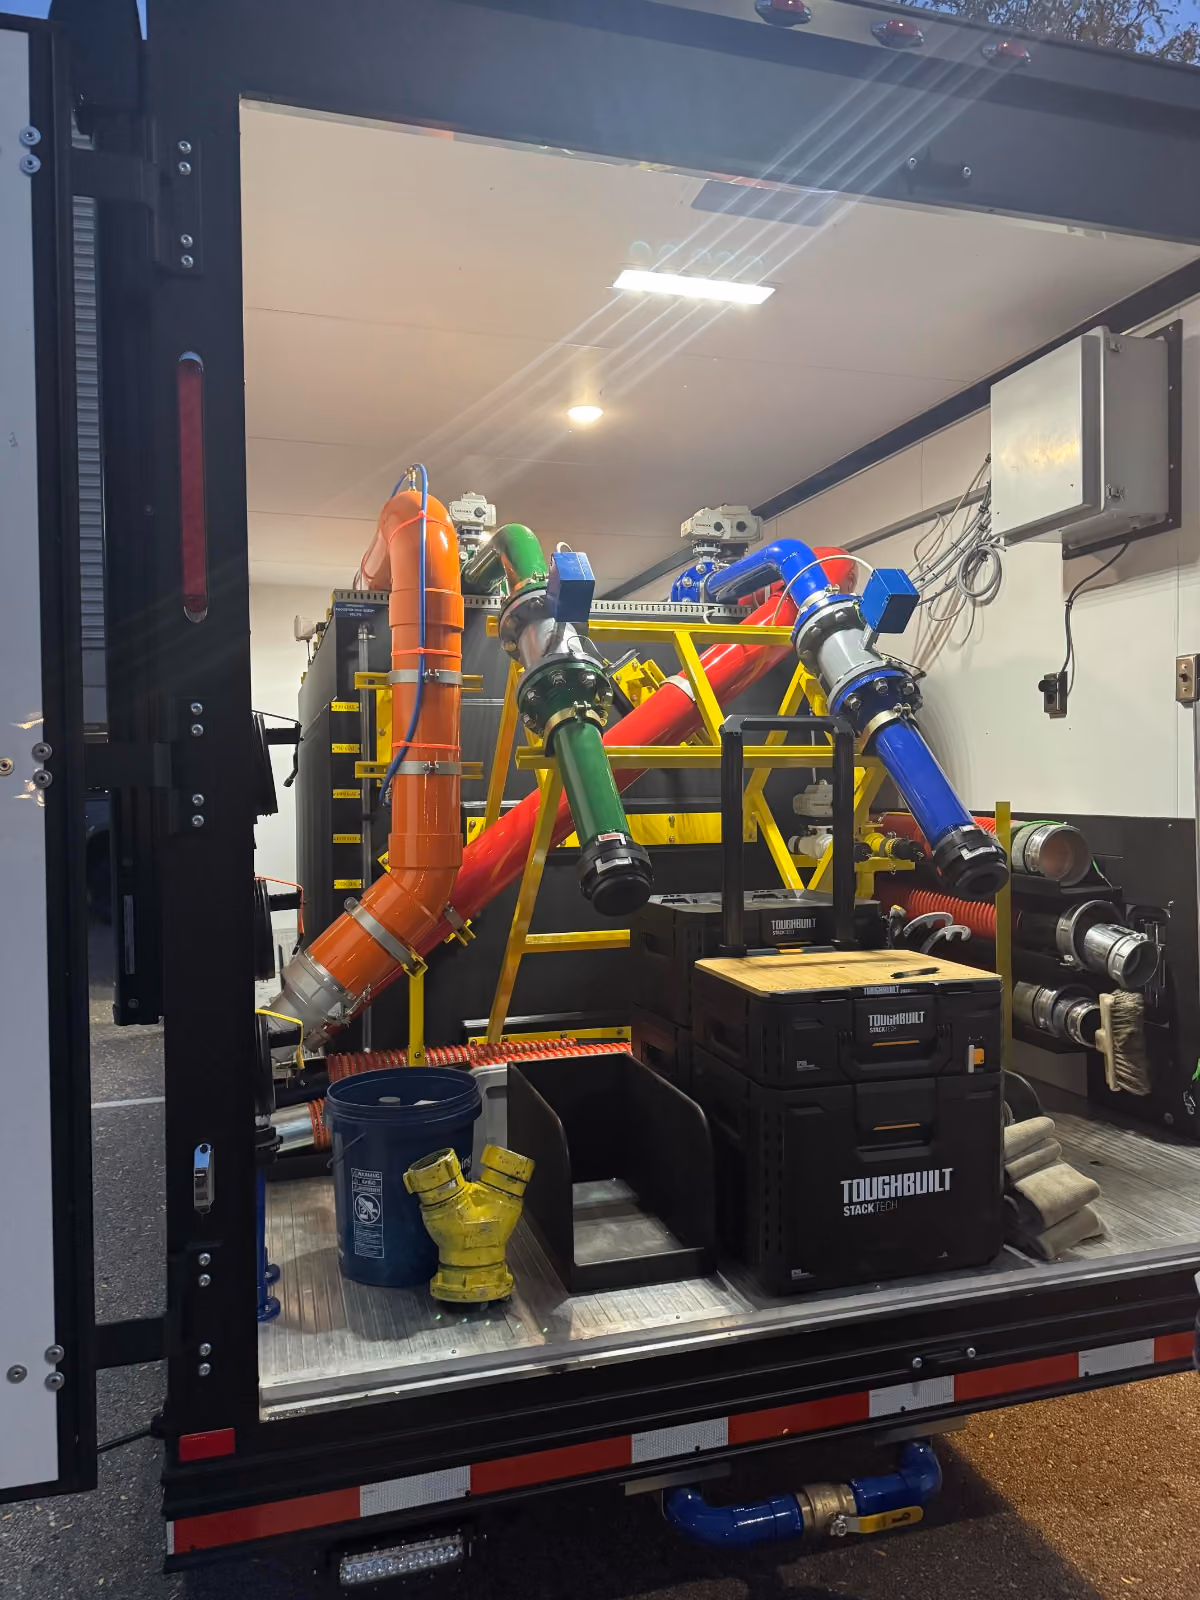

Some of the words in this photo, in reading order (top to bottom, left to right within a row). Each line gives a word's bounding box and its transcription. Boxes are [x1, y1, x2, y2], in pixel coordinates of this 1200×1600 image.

[771, 918, 816, 930] TOUGHBUILT
[868, 1011, 925, 1027] TOUGHBUILT
[840, 1168, 954, 1204] TOUGHBUILT
[843, 1199, 898, 1217] STACKTECH
